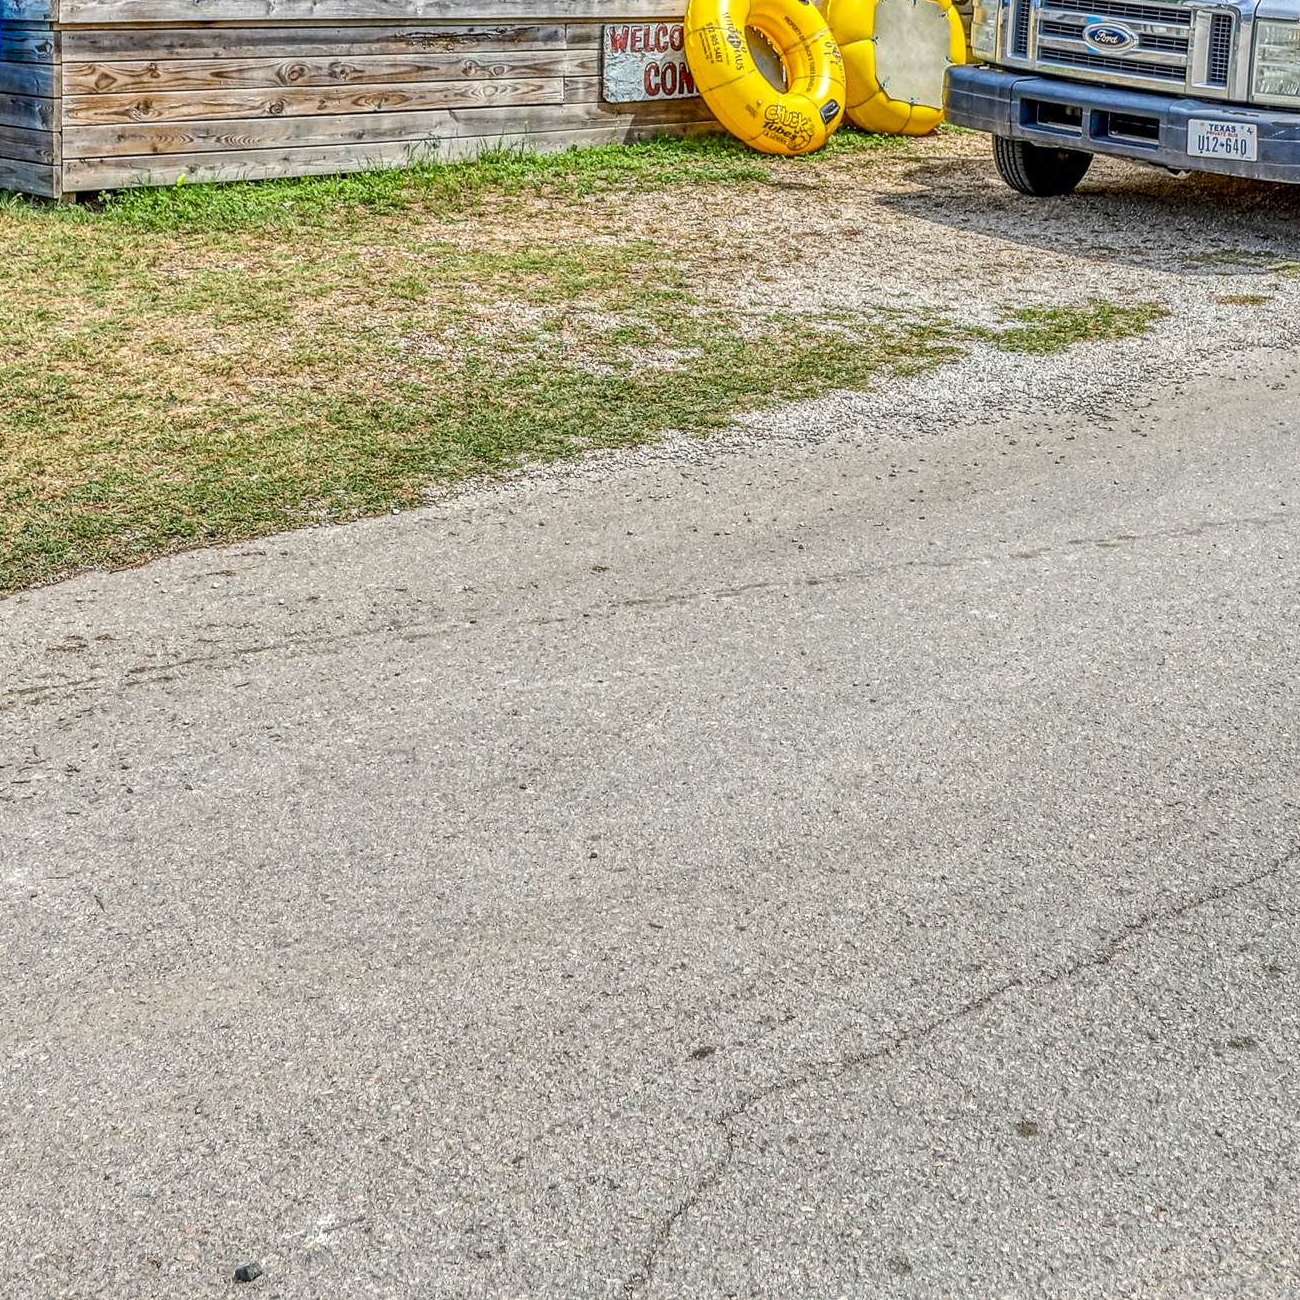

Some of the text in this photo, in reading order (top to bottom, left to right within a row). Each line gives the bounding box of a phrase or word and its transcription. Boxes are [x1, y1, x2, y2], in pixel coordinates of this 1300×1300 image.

[1094, 30, 1119, 44] Ford
[643, 61, 701, 97] CON
[762, 120, 798, 141] Tubes
[1208, 123, 1237, 133] TEXAS
